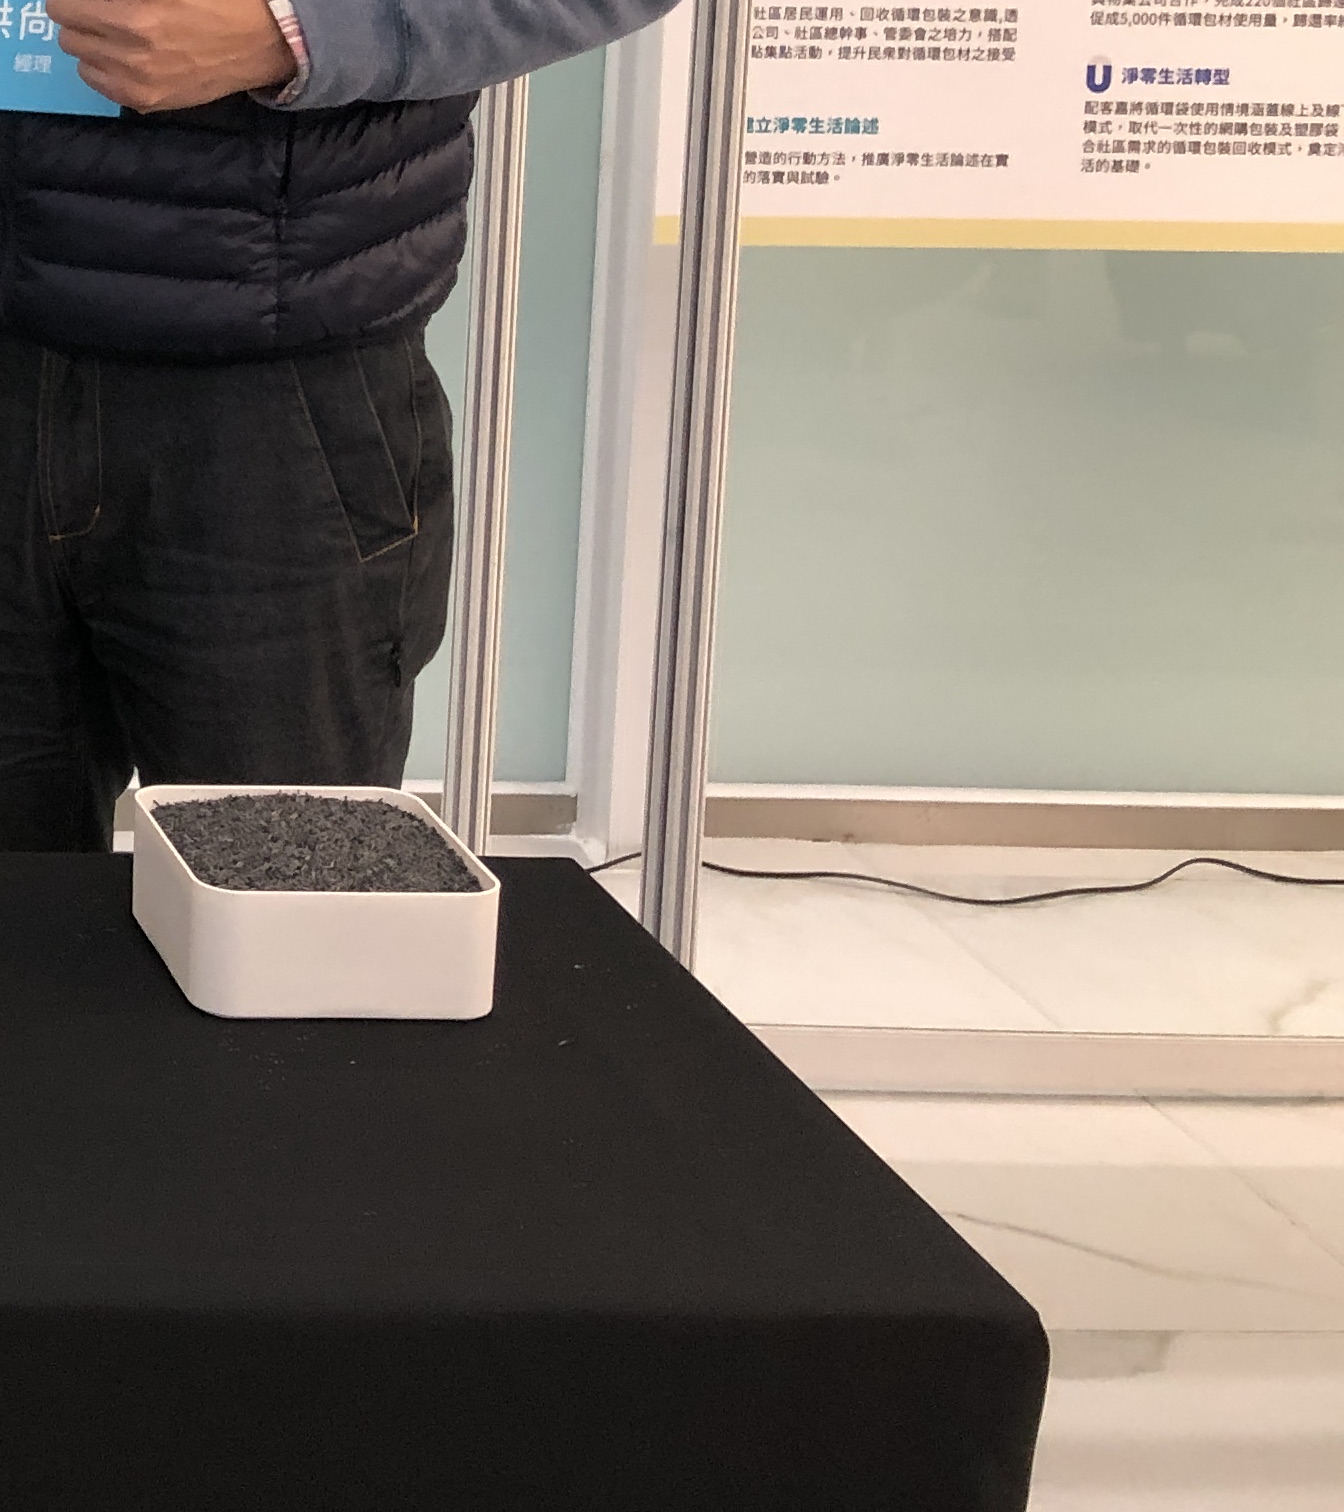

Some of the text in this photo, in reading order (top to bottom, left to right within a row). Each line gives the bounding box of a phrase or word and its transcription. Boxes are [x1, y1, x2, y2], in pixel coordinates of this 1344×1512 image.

[13, 55, 52, 72] 經理
[1121, 68, 1230, 86] 淨零生活轉型
[1081, 159, 1151, 174] 活的基礎。
